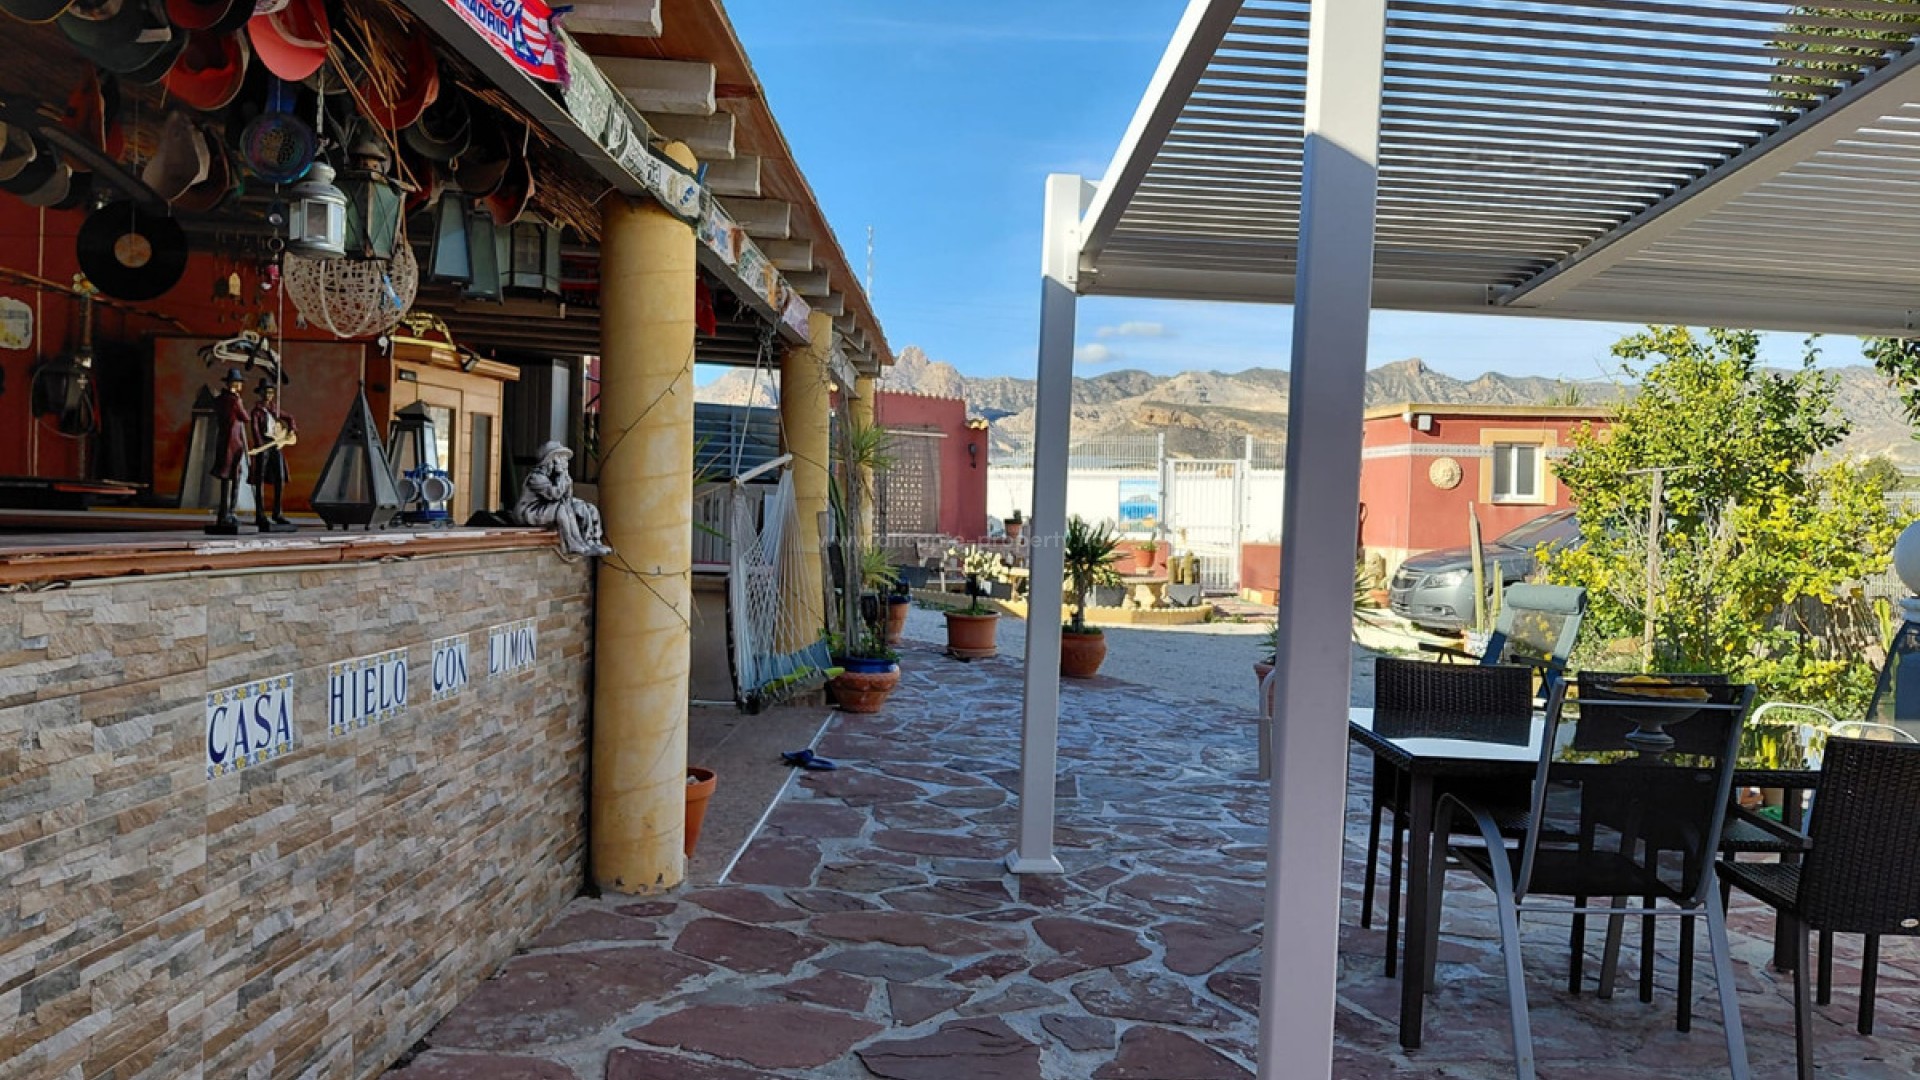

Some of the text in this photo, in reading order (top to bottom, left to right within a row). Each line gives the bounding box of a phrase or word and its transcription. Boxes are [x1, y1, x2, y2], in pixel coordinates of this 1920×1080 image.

[207, 692, 290, 764] CASA
[330, 660, 407, 725] HIELO
[433, 647, 468, 691] CON
